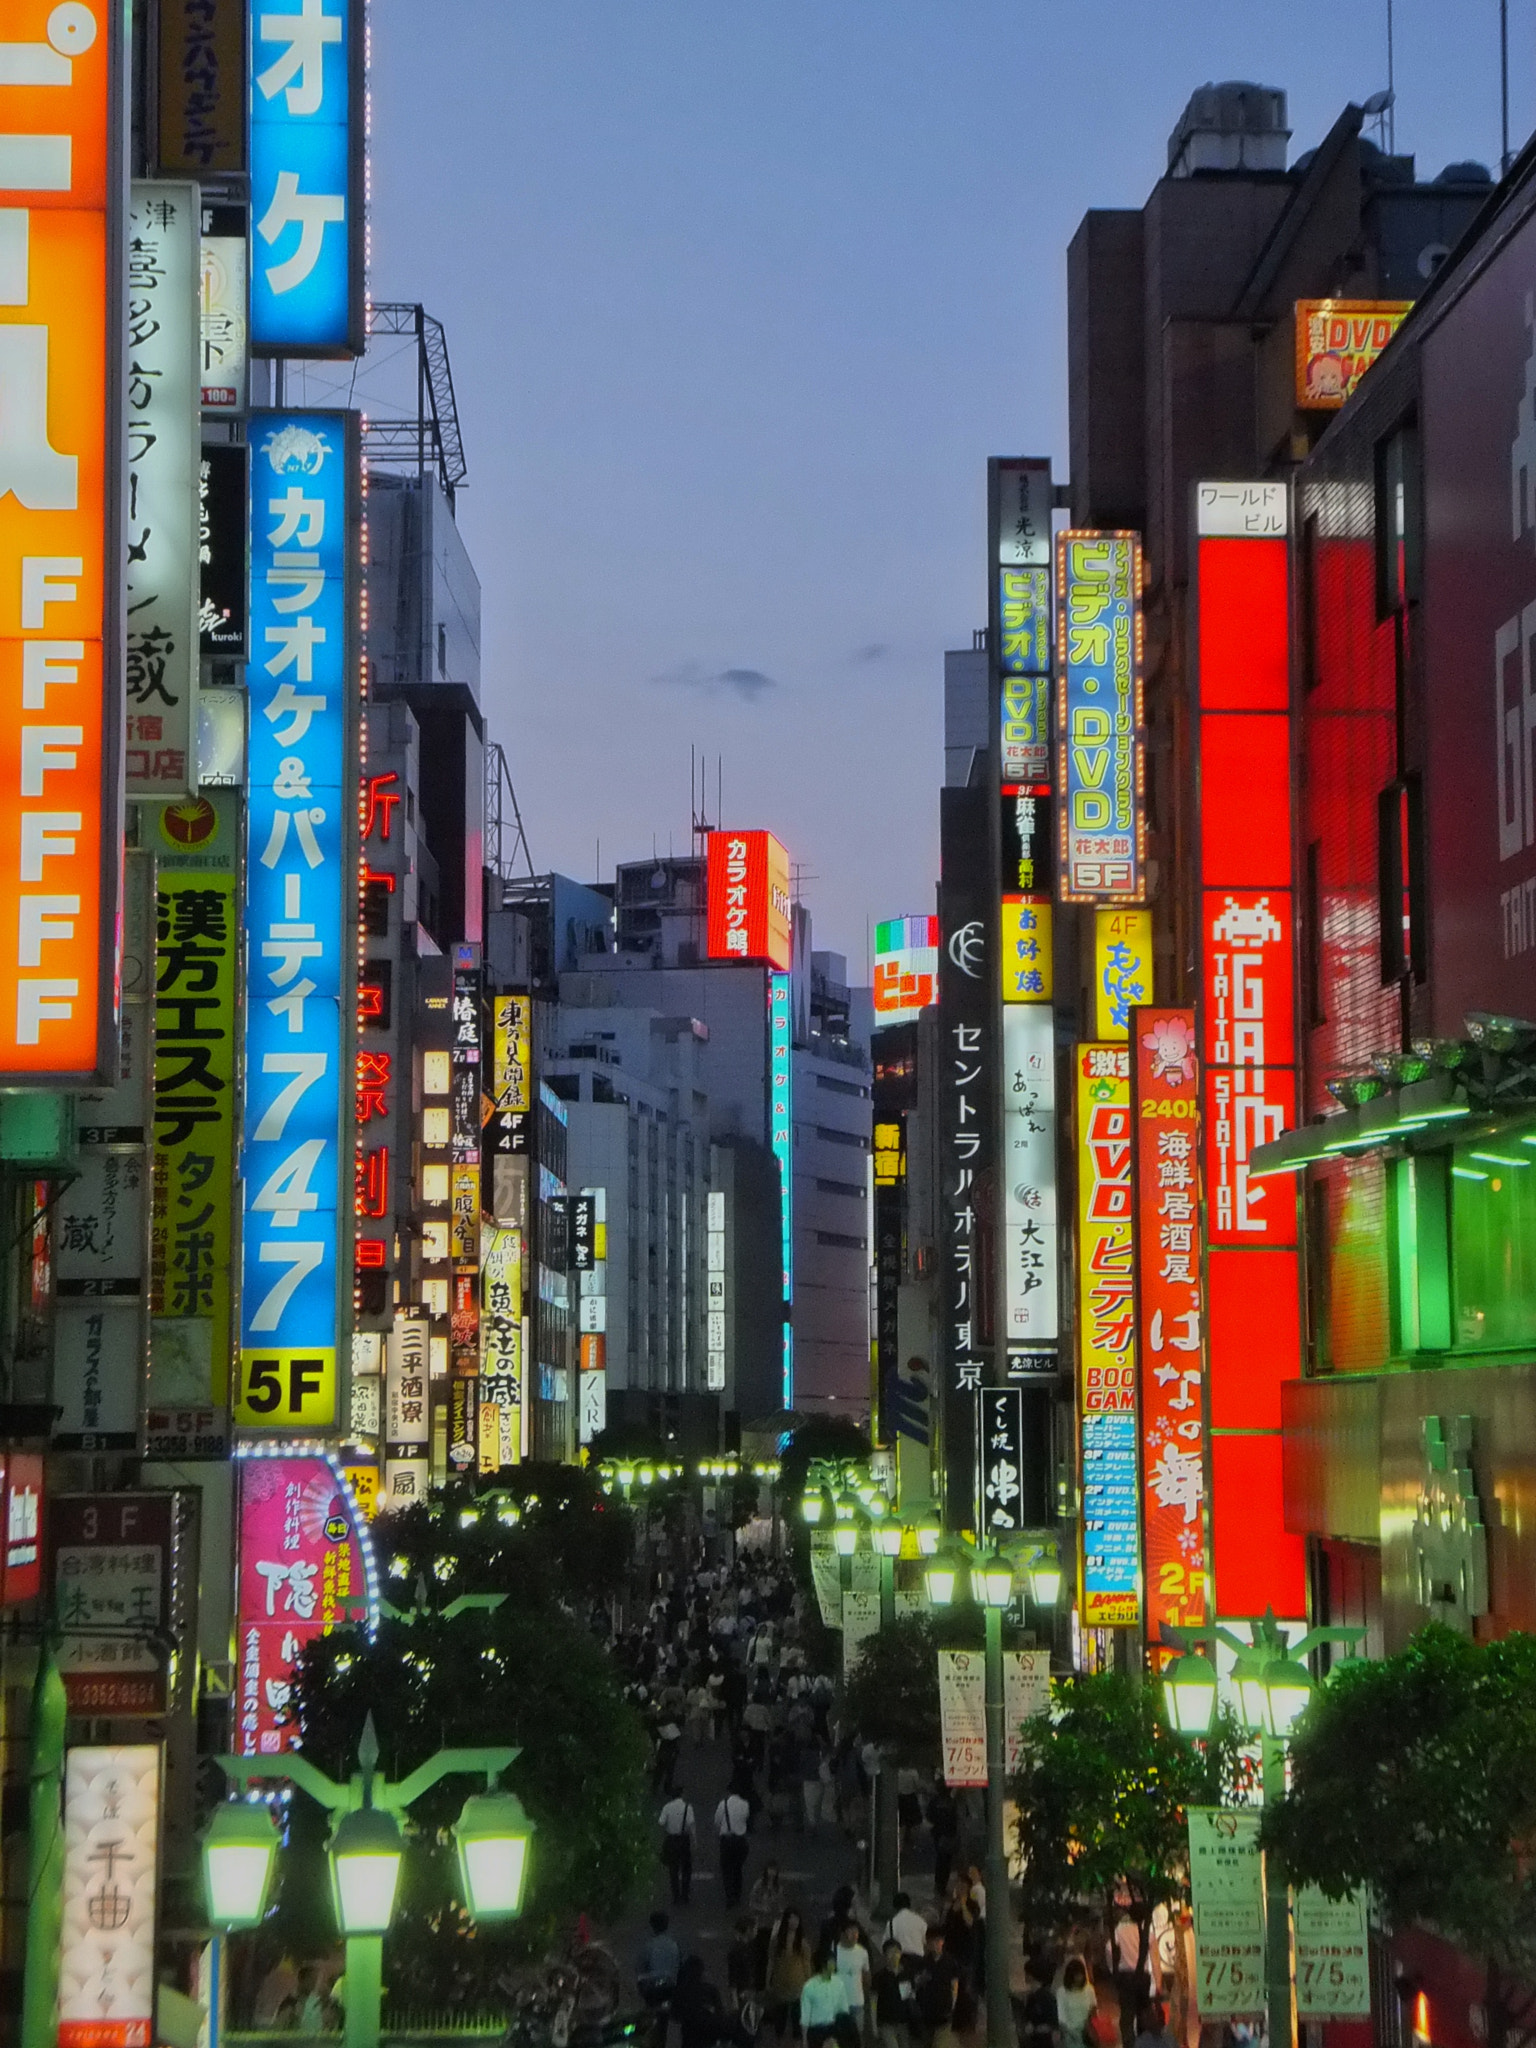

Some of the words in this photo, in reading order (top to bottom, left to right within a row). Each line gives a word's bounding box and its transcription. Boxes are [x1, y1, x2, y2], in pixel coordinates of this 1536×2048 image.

[256, 0, 345, 295] オケ
[1328, 318, 1392, 352] DVD
[1201, 488, 1277, 507] ワールド
[1245, 514, 1283, 533] ビル
[211, 632, 243, 642] kuroki
[1004, 678, 1033, 742] DVD
[1006, 746, 1045, 757] 花太郎
[1006, 763, 1045, 779] 5F
[1076, 838, 1129, 855] 花太郎
[1018, 859, 1034, 889] 高村
[1077, 864, 1129, 888] 5F
[1110, 917, 1137, 935] 4F
[1016, 910, 1045, 994] お好焼
[154, 889, 229, 1147] 漢方エステ
[1213, 953, 1230, 1064] TAITO
[453, 1051, 465, 1062] 7F
[500, 1112, 523, 1128] 4F
[86, 1129, 118, 1143] 3F
[499, 1135, 524, 1149] 4F
[452, 1151, 465, 1163] 7F
[1215, 1075, 1232, 1231] STATION
[124, 1157, 142, 1191] 会津
[576, 1202, 588, 1238] メガネ
[1158, 1129, 1196, 1285] 海鮮居酒屋
[60, 1214, 98, 1254] 蔵
[173, 1151, 216, 1317] タンポポ
[1019, 1218, 1045, 1296] 大江戸
[84, 1280, 116, 1296] 2F
[1010, 1356, 1054, 1371] 光涼ビル
[246, 1359, 325, 1414] 5F
[397, 1444, 418, 1458] 1F
[284, 1481, 303, 1549] 創作料理
